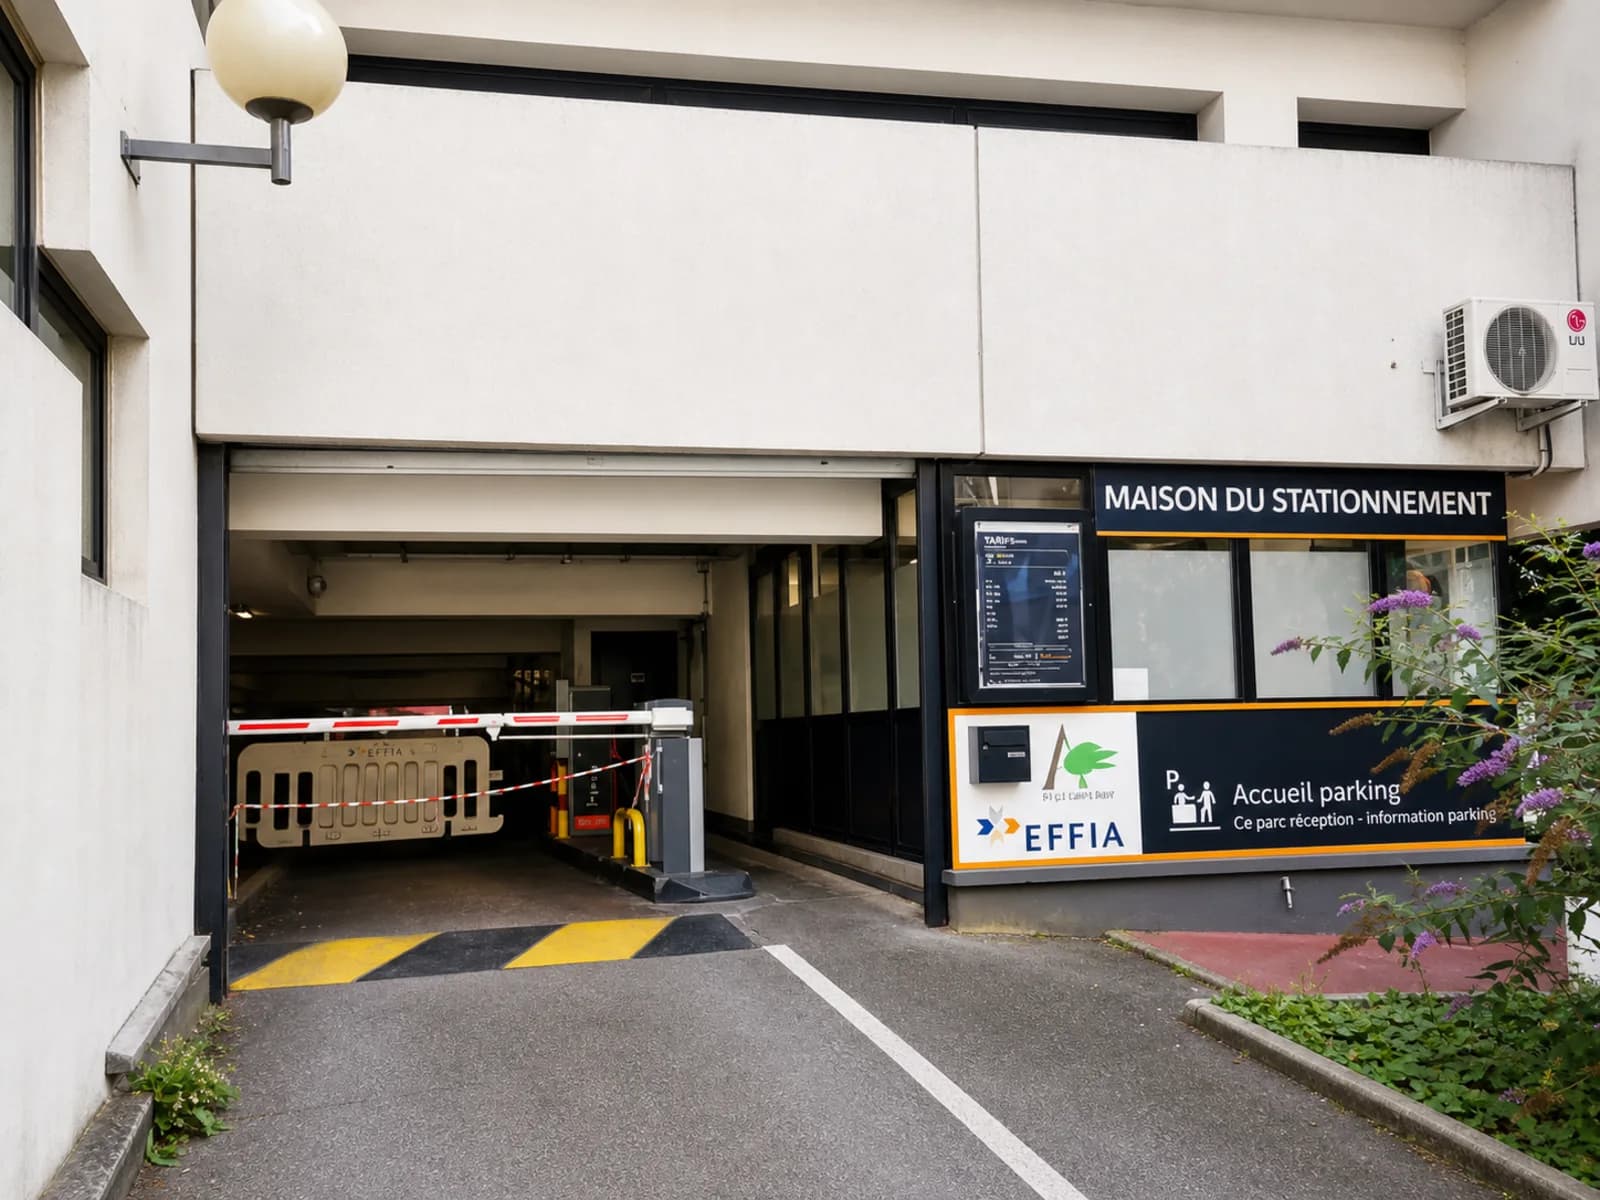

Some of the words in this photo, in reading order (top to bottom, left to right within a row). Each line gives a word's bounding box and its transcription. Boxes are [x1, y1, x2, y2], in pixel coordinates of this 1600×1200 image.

[1104, 485, 1217, 512] MAISON
[1226, 487, 1264, 513] DU
[1272, 488, 1491, 516] STATIONNEMENT
[1166, 770, 1180, 790] P
[1232, 781, 1314, 806] Accueil
[1320, 780, 1401, 807] parking
[1233, 816, 1253, 830] Ce
[1256, 817, 1286, 832] parc
[1289, 812, 1354, 831] réception
[1366, 809, 1444, 825] information
[1448, 807, 1497, 824] parking
[1025, 822, 1124, 852] EFFIA
